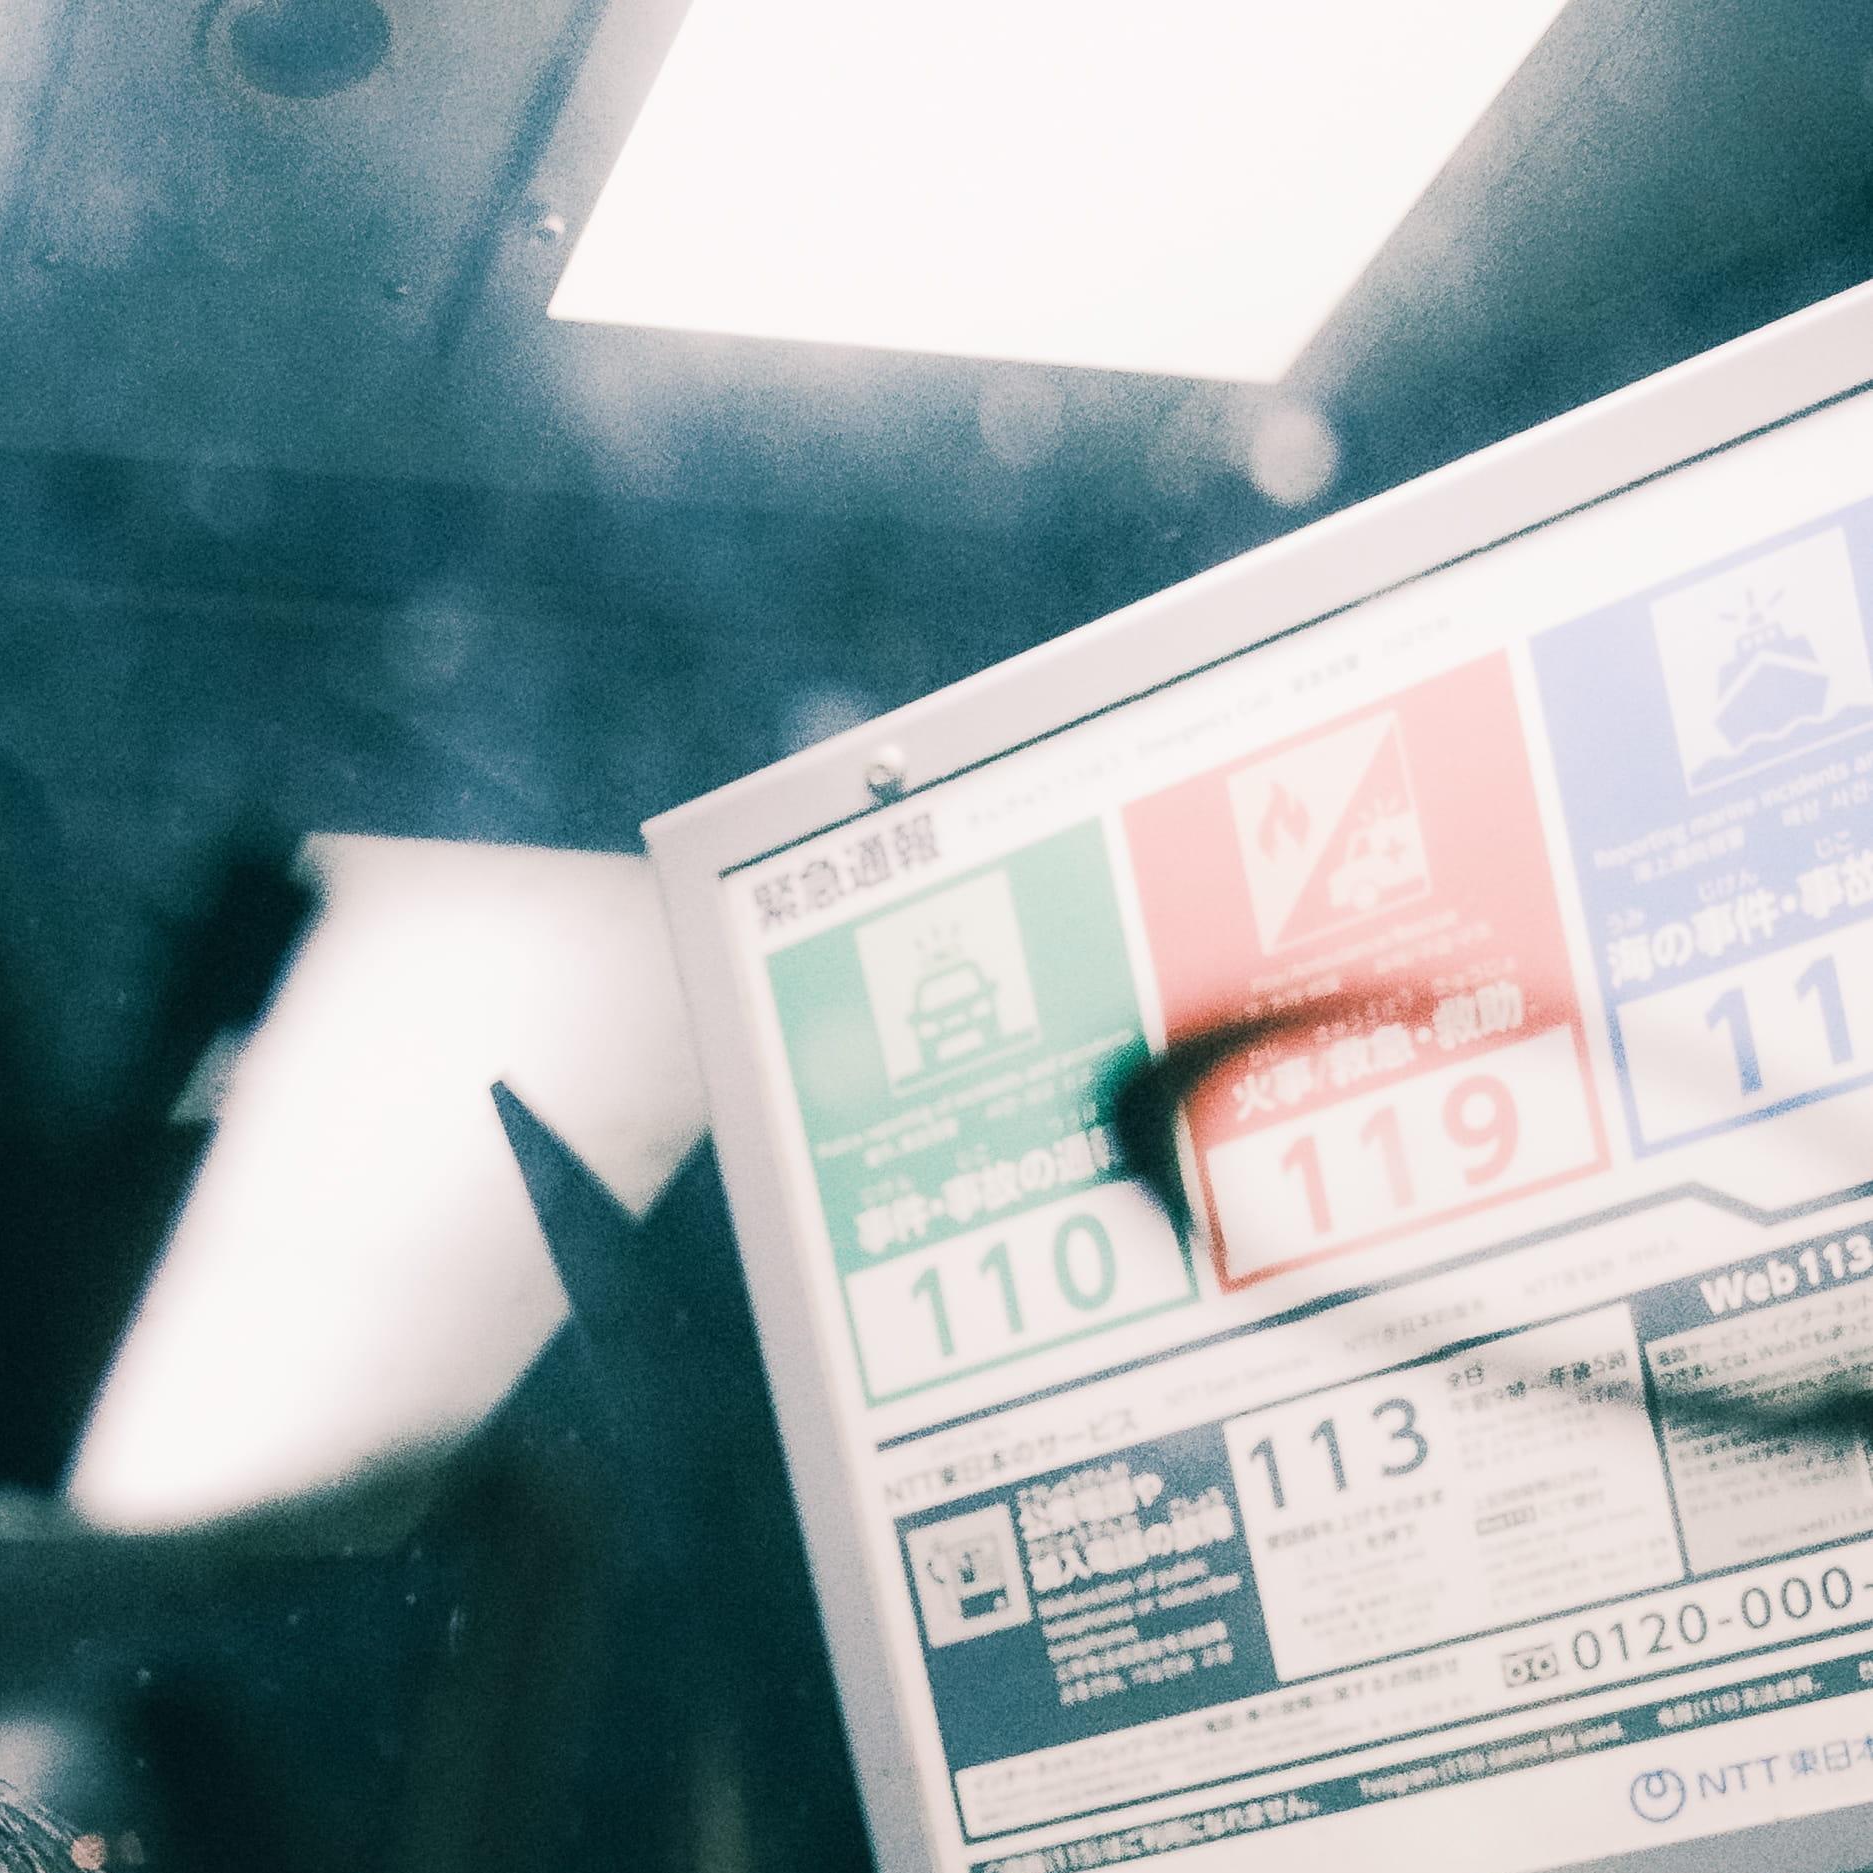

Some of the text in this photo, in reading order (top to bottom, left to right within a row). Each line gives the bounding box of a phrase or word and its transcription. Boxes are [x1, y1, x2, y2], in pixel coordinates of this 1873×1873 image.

[752, 811, 943, 932] 緊急通報
[1280, 1073, 1520, 1237] 119
[910, 1211, 1118, 1357] 110
[1701, 1236, 1873, 1314] Web113
[881, 1406, 1140, 1507] NTT東日本のサービス
[1248, 1394, 1432, 1513] 113
